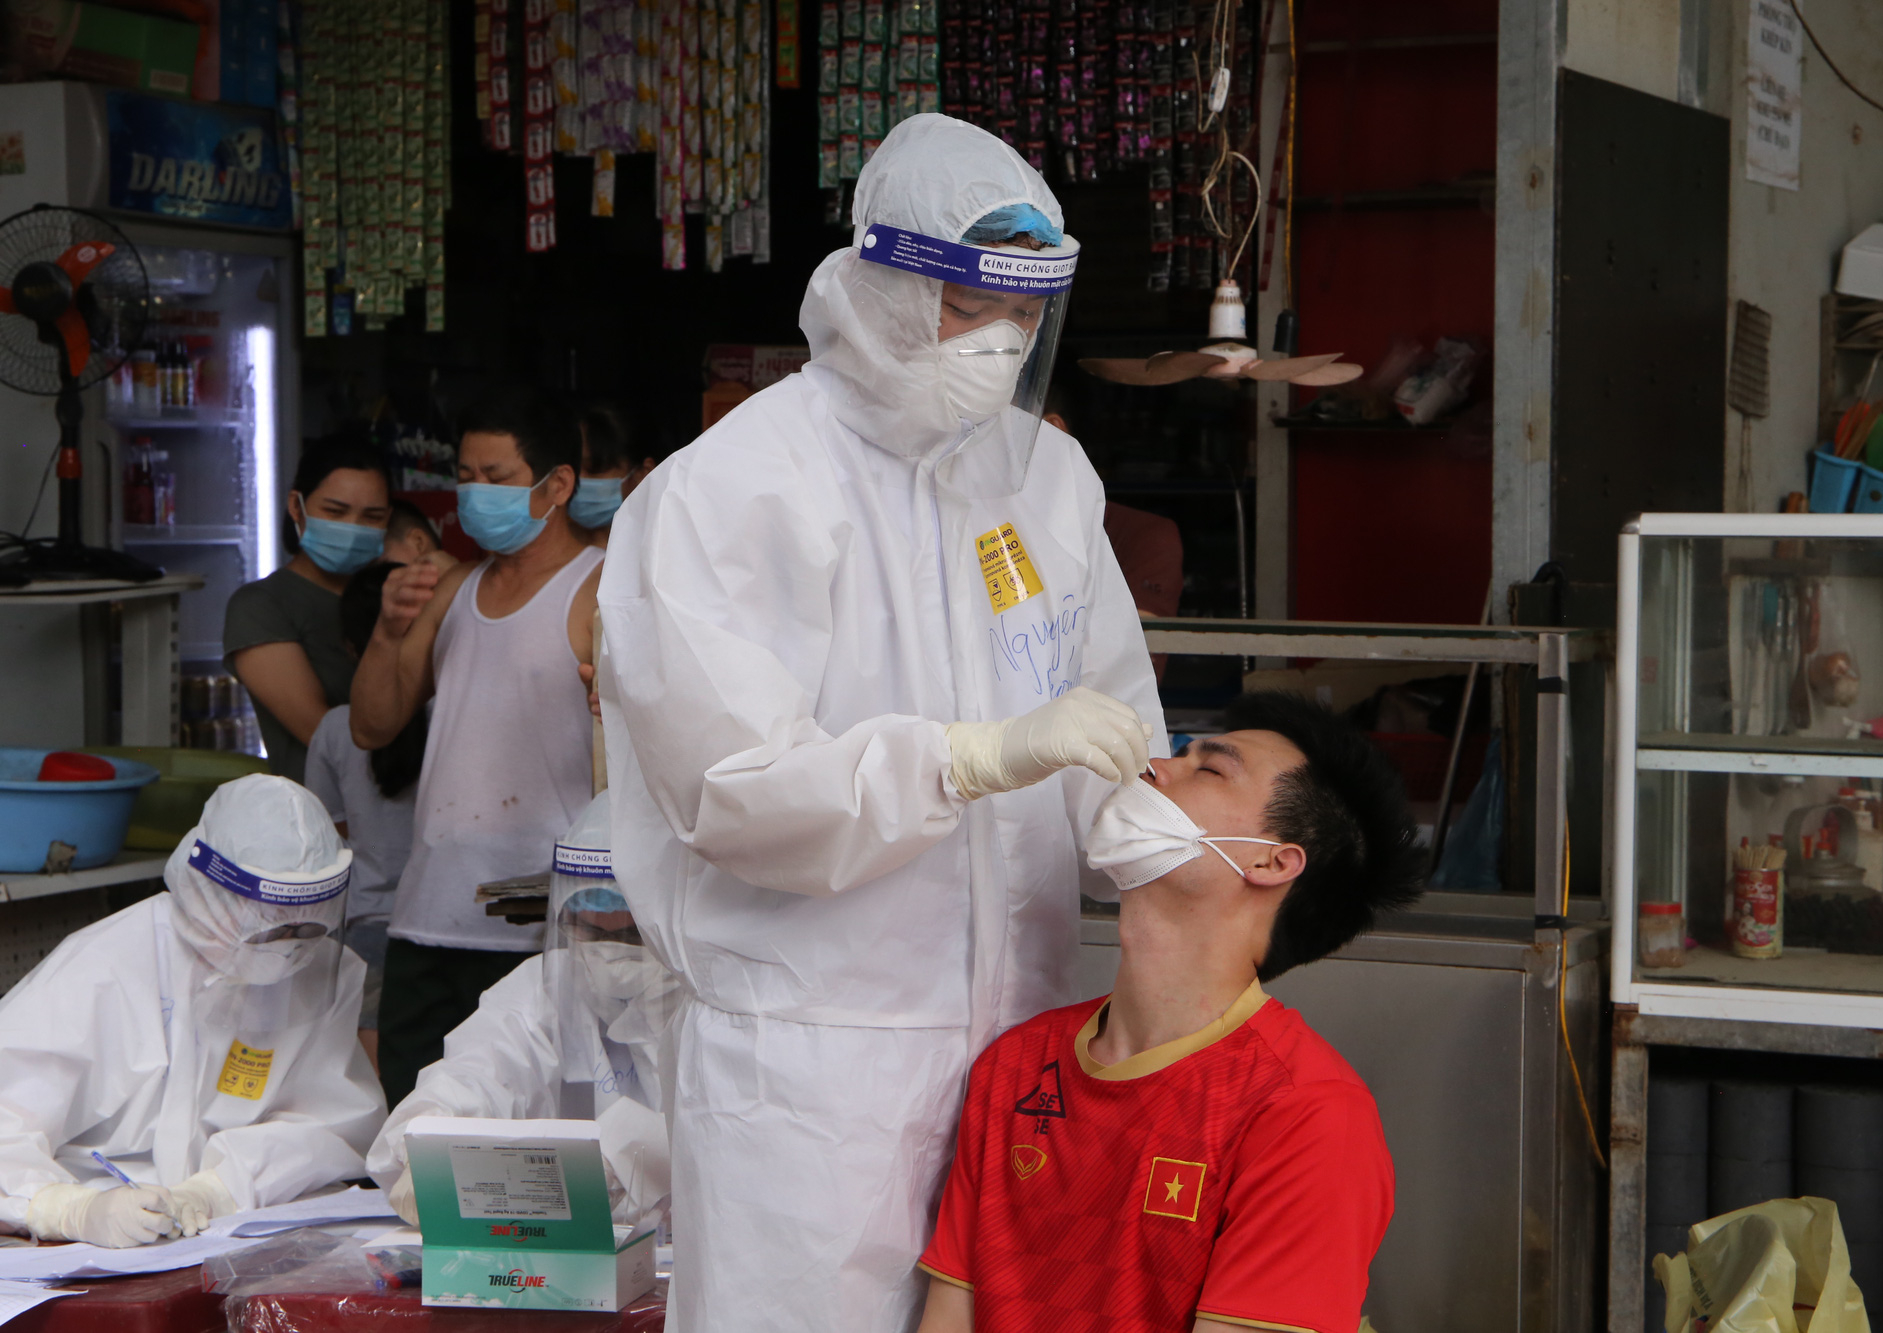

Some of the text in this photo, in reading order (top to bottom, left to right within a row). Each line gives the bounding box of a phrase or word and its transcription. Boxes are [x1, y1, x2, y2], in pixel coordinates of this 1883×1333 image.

[128, 152, 282, 206] DARLING
[983, 259, 1012, 271] KÍNH
[1016, 262, 1050, 274] CHỐNG
[1053, 263, 1068, 275] GIỌT
[981, 275, 1001, 285] Kính
[1003, 278, 1018, 287] bảo
[1020, 281, 1028, 290] vệ
[1029, 280, 1050, 288] khuôn
[999, 540, 1019, 555] PRO
[571, 853, 600, 862] CHỐNG
[262, 884, 284, 893] KÍNH
[287, 886, 318, 894] CHỐNG
[1038, 1092, 1059, 1109] SE
[490, 1225, 548, 1237] TRUELINE
[489, 1275, 546, 1288] TRUELINE
